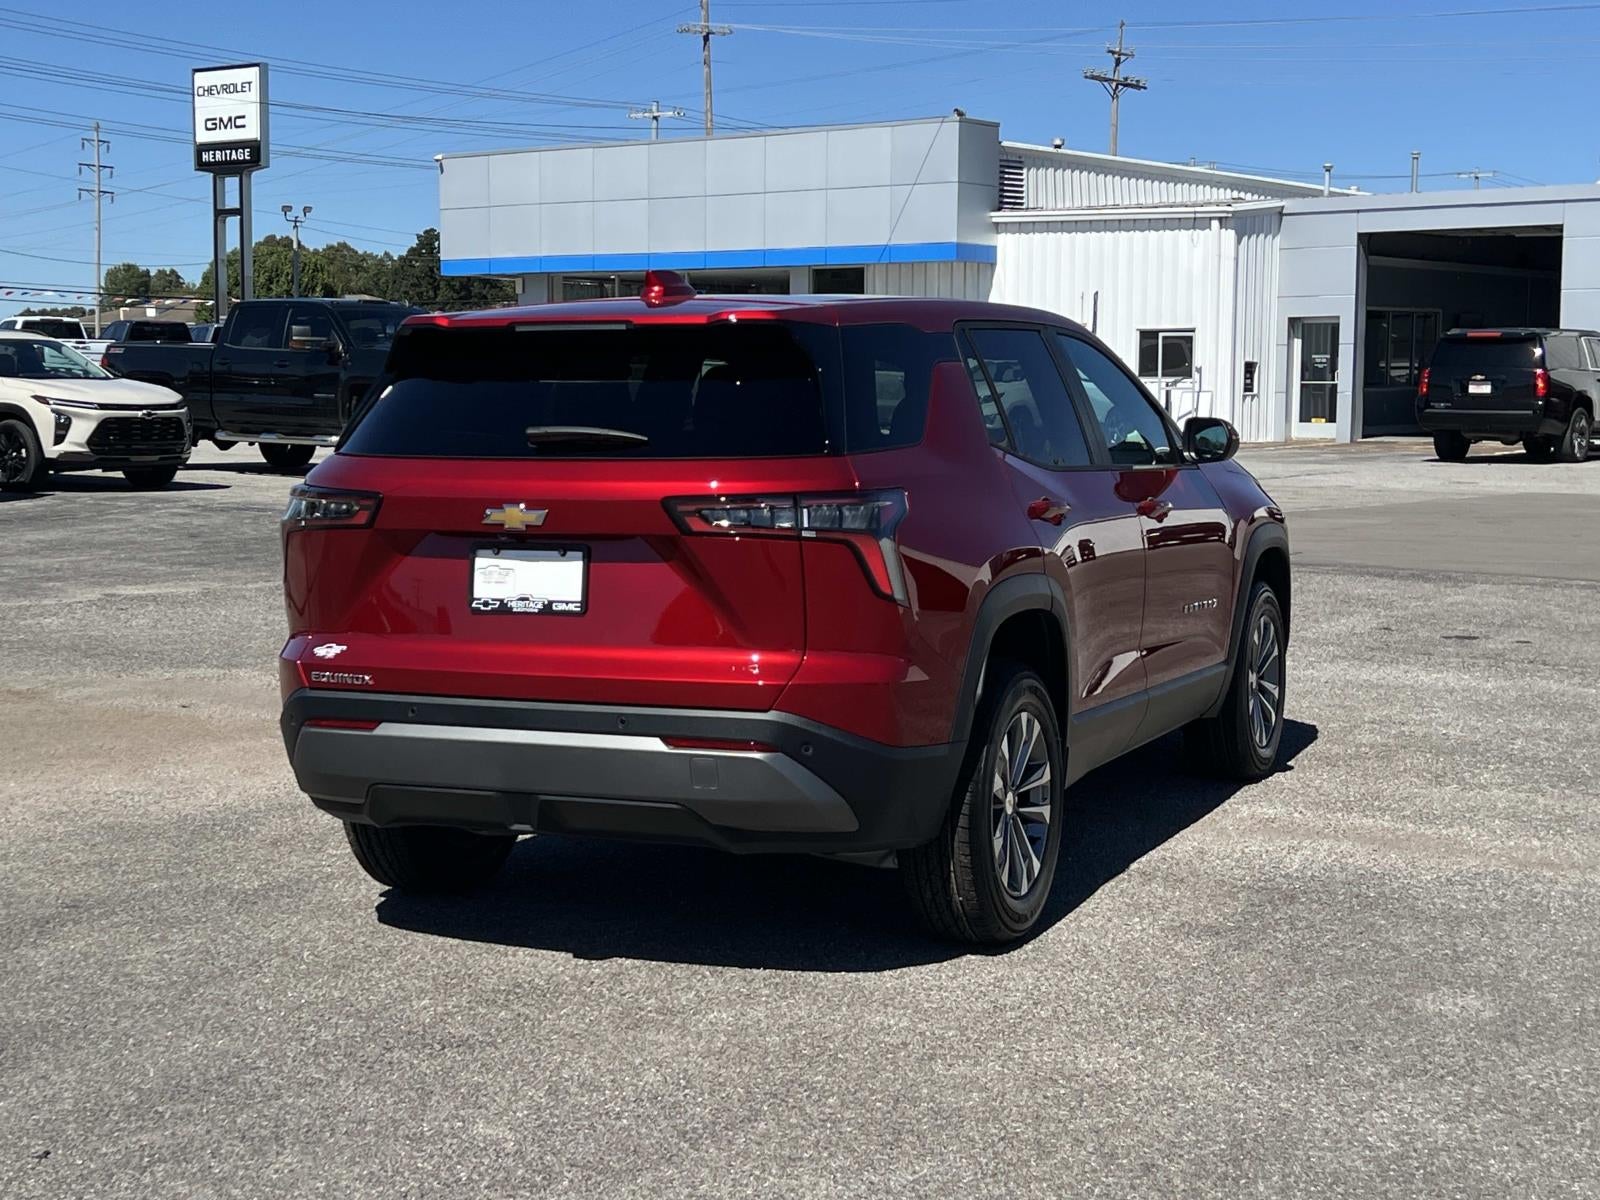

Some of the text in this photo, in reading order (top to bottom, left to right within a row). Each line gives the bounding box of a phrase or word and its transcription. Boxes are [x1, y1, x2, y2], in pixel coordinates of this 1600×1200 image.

[197, 81, 253, 97] CHEVROLET
[204, 114, 246, 131] GMC
[202, 148, 251, 162] HERITAGE
[507, 600, 581, 611] HERITAGE GMC
[311, 671, 375, 685] EQUINOX
